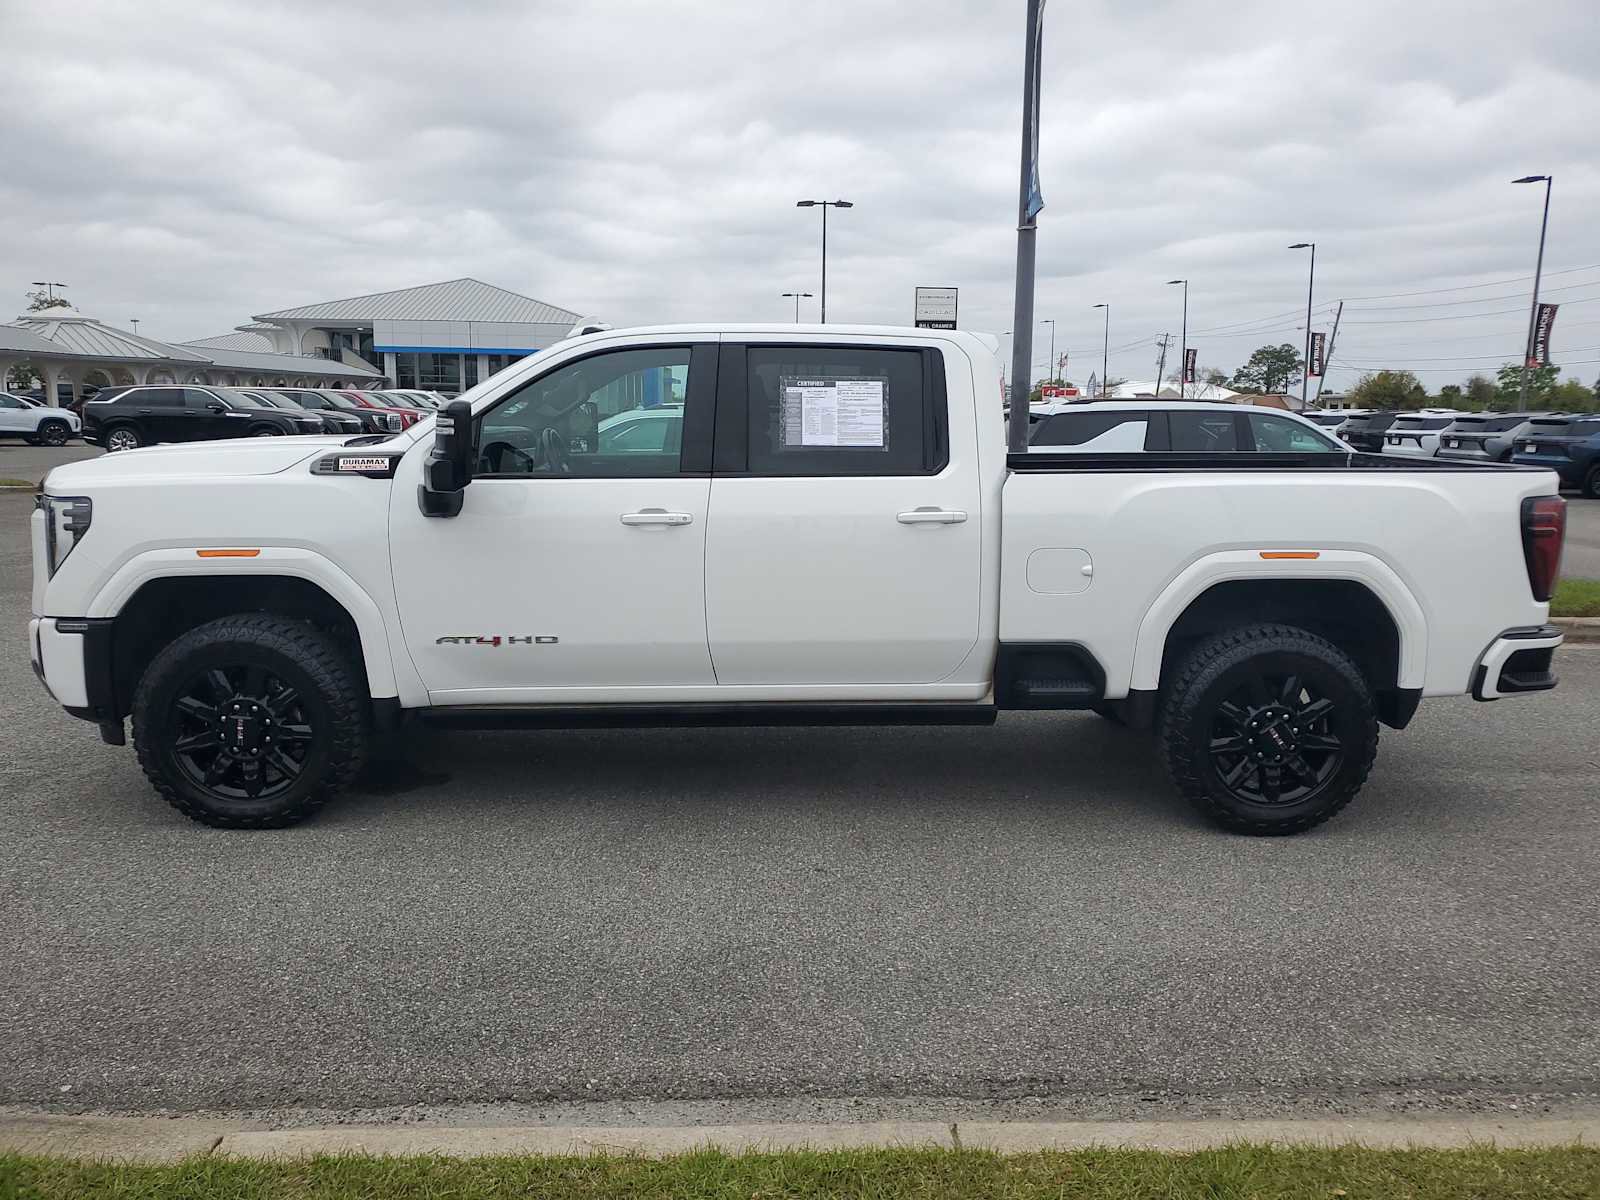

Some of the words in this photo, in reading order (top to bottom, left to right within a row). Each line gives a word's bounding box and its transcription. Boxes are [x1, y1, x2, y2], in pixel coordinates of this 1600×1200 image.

[1536, 307, 1552, 341] TRUCKS
[1313, 335, 1321, 360] TRUCKS
[1535, 343, 1545, 363] NEW
[435, 636, 501, 647] AT4
[508, 636, 558, 644] HD
